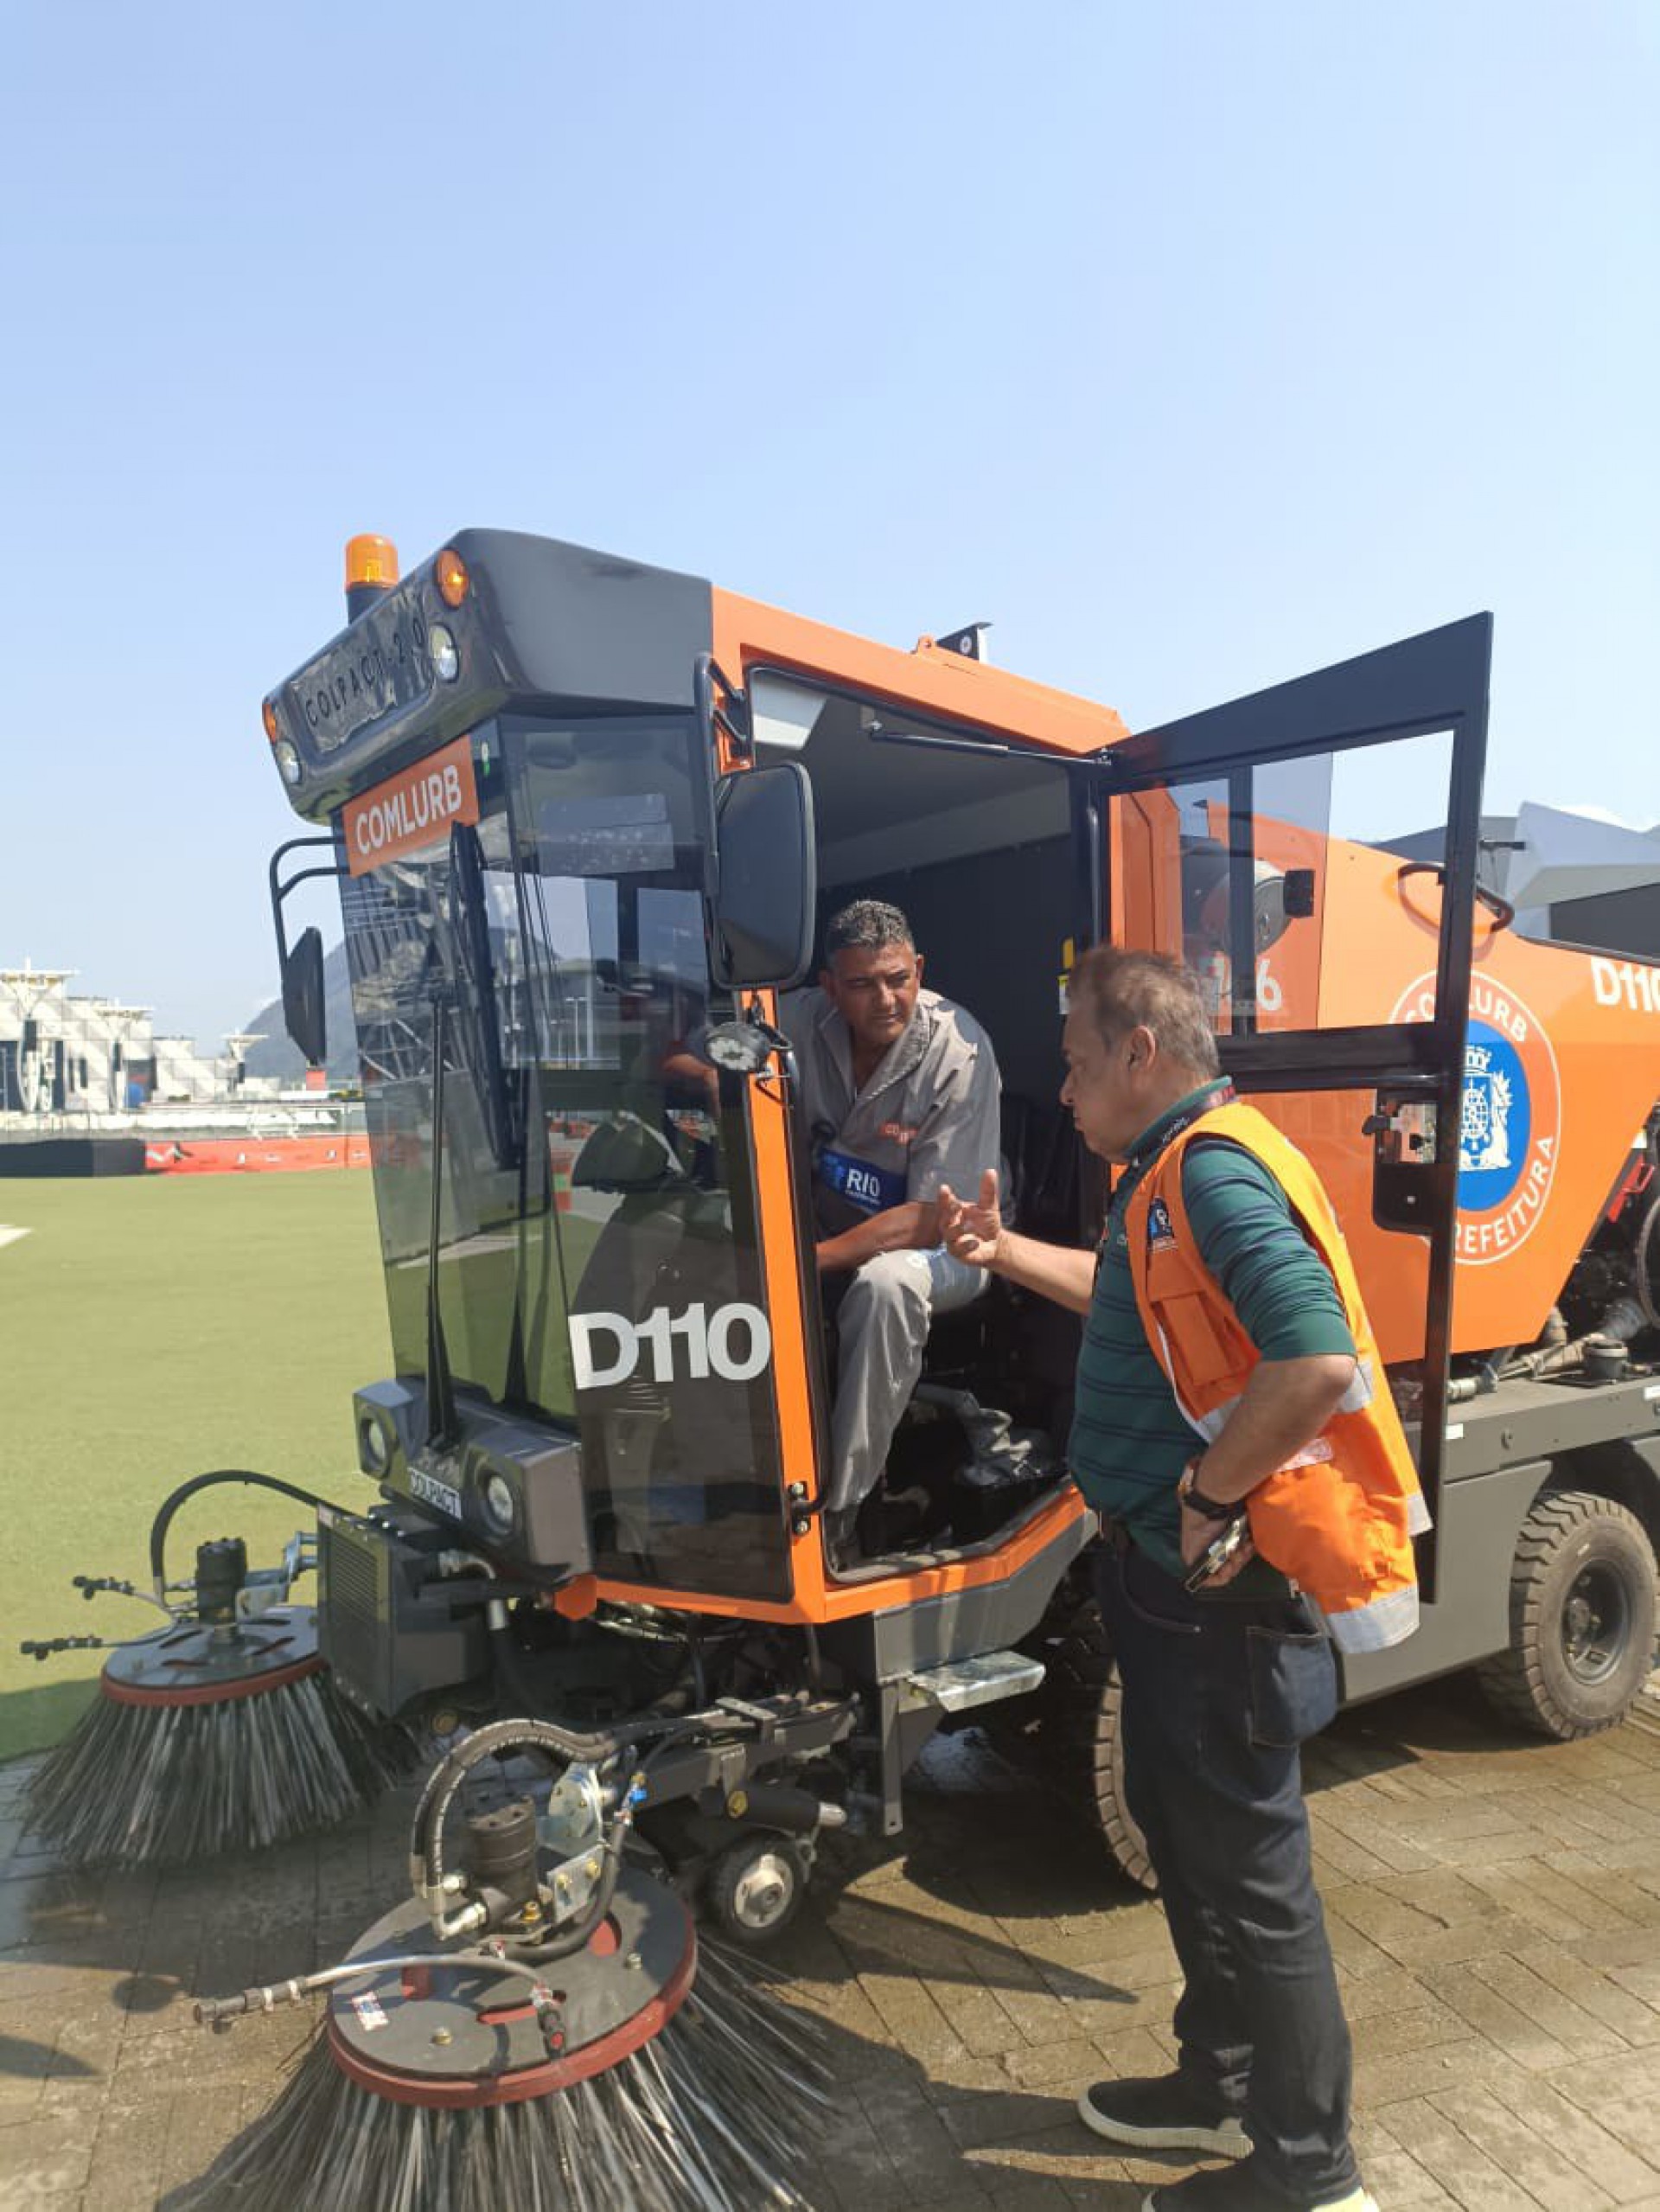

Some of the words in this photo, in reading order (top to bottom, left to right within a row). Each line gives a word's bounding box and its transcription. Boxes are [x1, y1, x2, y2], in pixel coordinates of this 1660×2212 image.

[356, 764, 462, 854] COMLURB
[846, 1168, 880, 1197] RIO
[568, 1302, 771, 1390] D110
